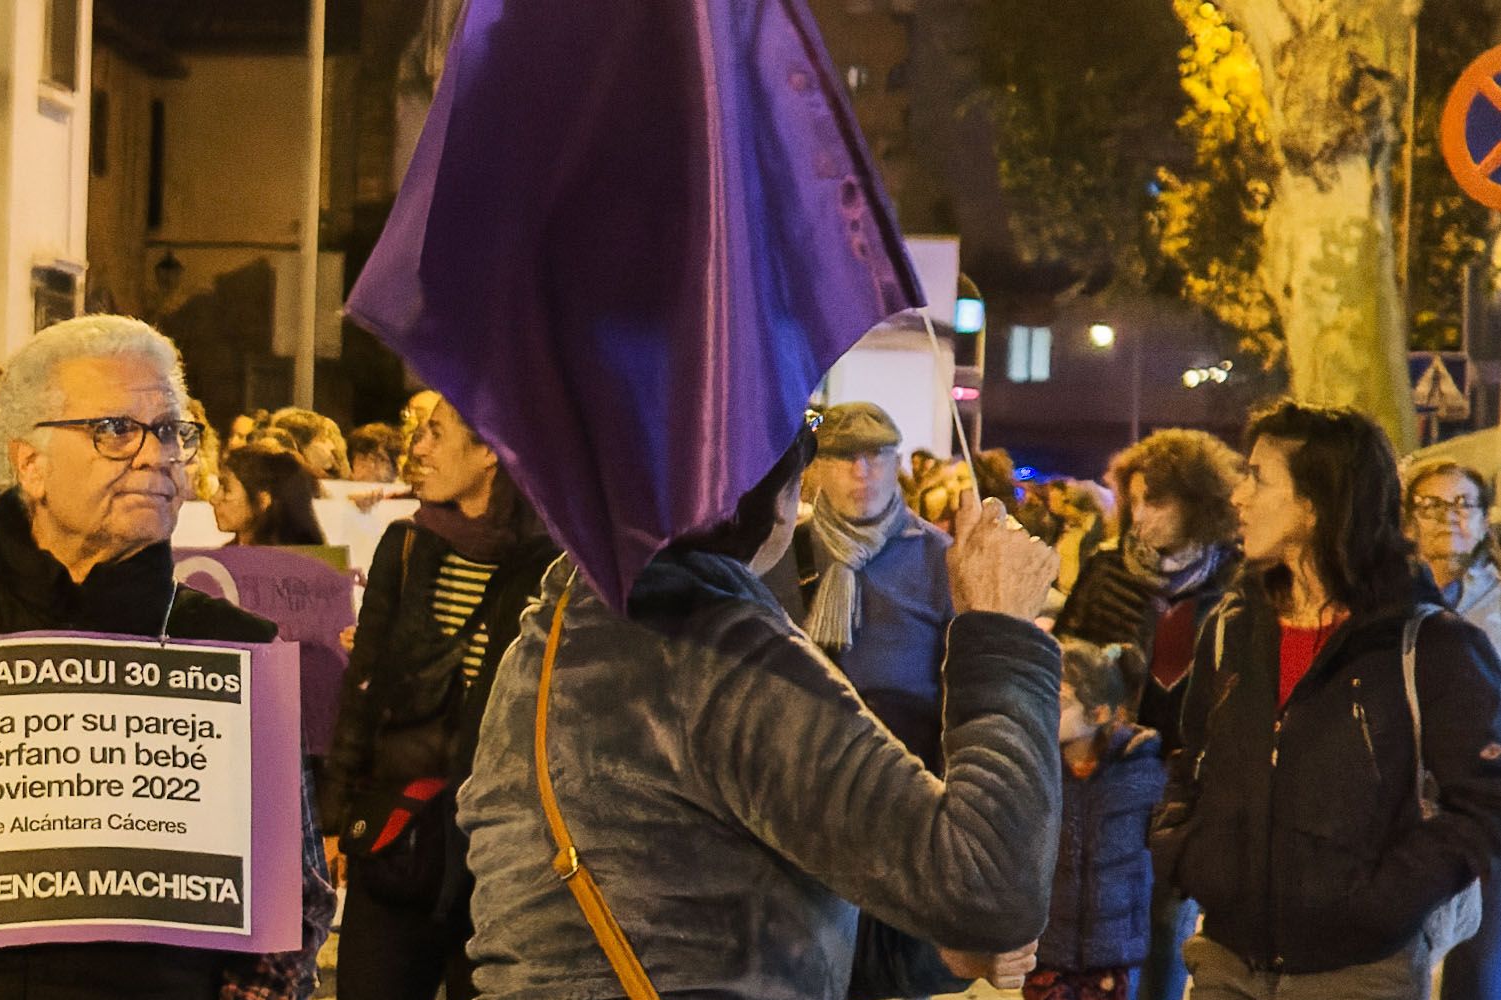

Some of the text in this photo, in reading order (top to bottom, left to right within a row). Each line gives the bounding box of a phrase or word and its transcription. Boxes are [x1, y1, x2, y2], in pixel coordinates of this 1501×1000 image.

[125, 662, 160, 686] 30
[168, 665, 241, 693] años
[24, 713, 74, 738] por
[82, 714, 116, 732] su
[125, 713, 222, 742] pareja.
[90, 746, 126, 765] un
[135, 742, 207, 770] bebé
[132, 775, 201, 802] 2022
[9, 813, 102, 835] Alcántara
[107, 813, 187, 835] Cáceres
[89, 869, 241, 906] MACHISTA
